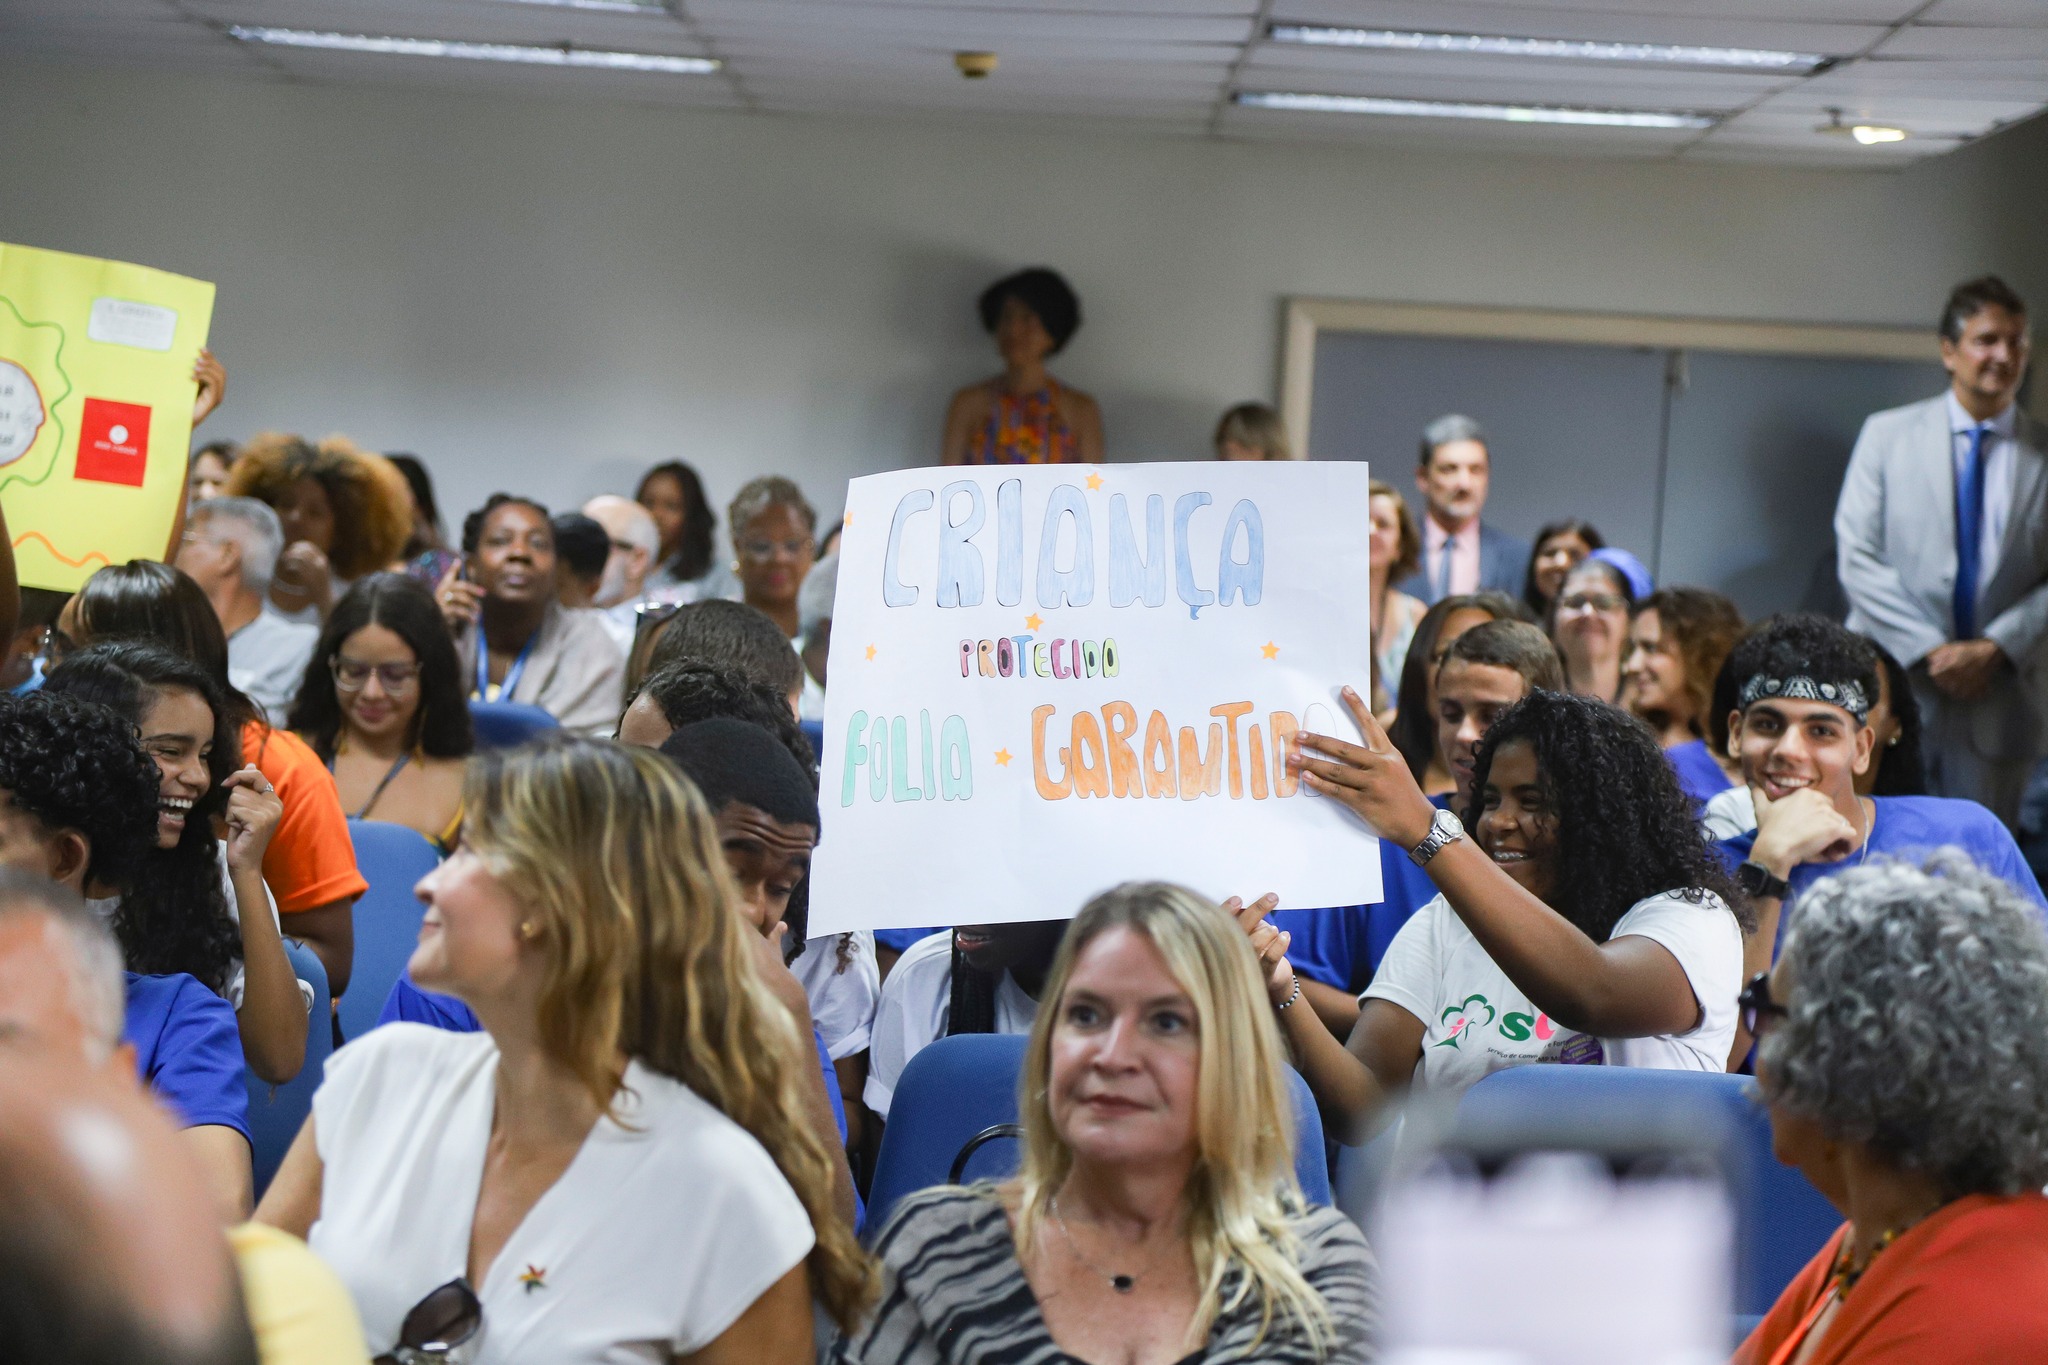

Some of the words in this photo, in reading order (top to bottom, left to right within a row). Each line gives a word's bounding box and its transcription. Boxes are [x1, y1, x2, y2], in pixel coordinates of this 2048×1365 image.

[882, 478, 1265, 621] CRIANÇA
[959, 634, 1121, 680] PROTEGIDA
[840, 708, 974, 809] FOLIA
